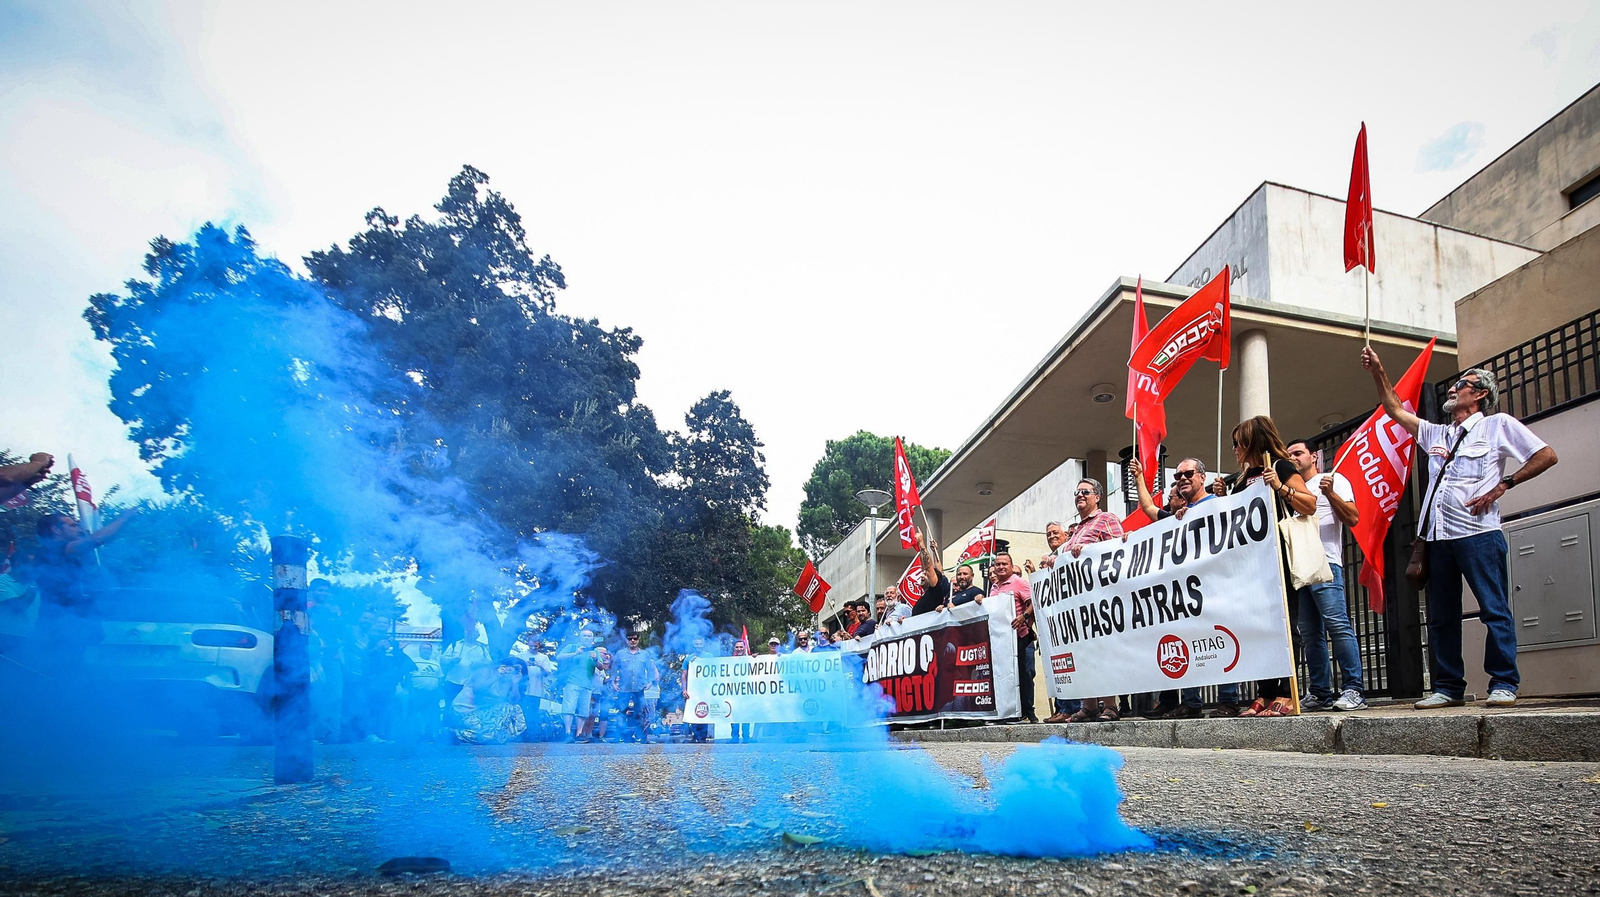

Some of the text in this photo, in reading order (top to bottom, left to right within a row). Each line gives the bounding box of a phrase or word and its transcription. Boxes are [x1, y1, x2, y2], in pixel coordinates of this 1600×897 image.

[1097, 548, 1125, 588] ES
[1126, 537, 1154, 579] MI
[1158, 496, 1269, 571] FUTURO
[1057, 608, 1080, 645] UN
[1079, 595, 1125, 641] PASO
[1130, 574, 1204, 630] ATRAS
[1160, 640, 1185, 657] UGT
[1191, 635, 1225, 654] FITAG
[862, 638, 917, 684] AARIO
[960, 648, 978, 662] UGT
[695, 658, 840, 678] POR EL CUMPLIMIENTO DE
[711, 680, 767, 696] CONVENIO
[770, 680, 785, 694] DE
[788, 678, 803, 694] LA
[955, 683, 985, 694] CCOO
